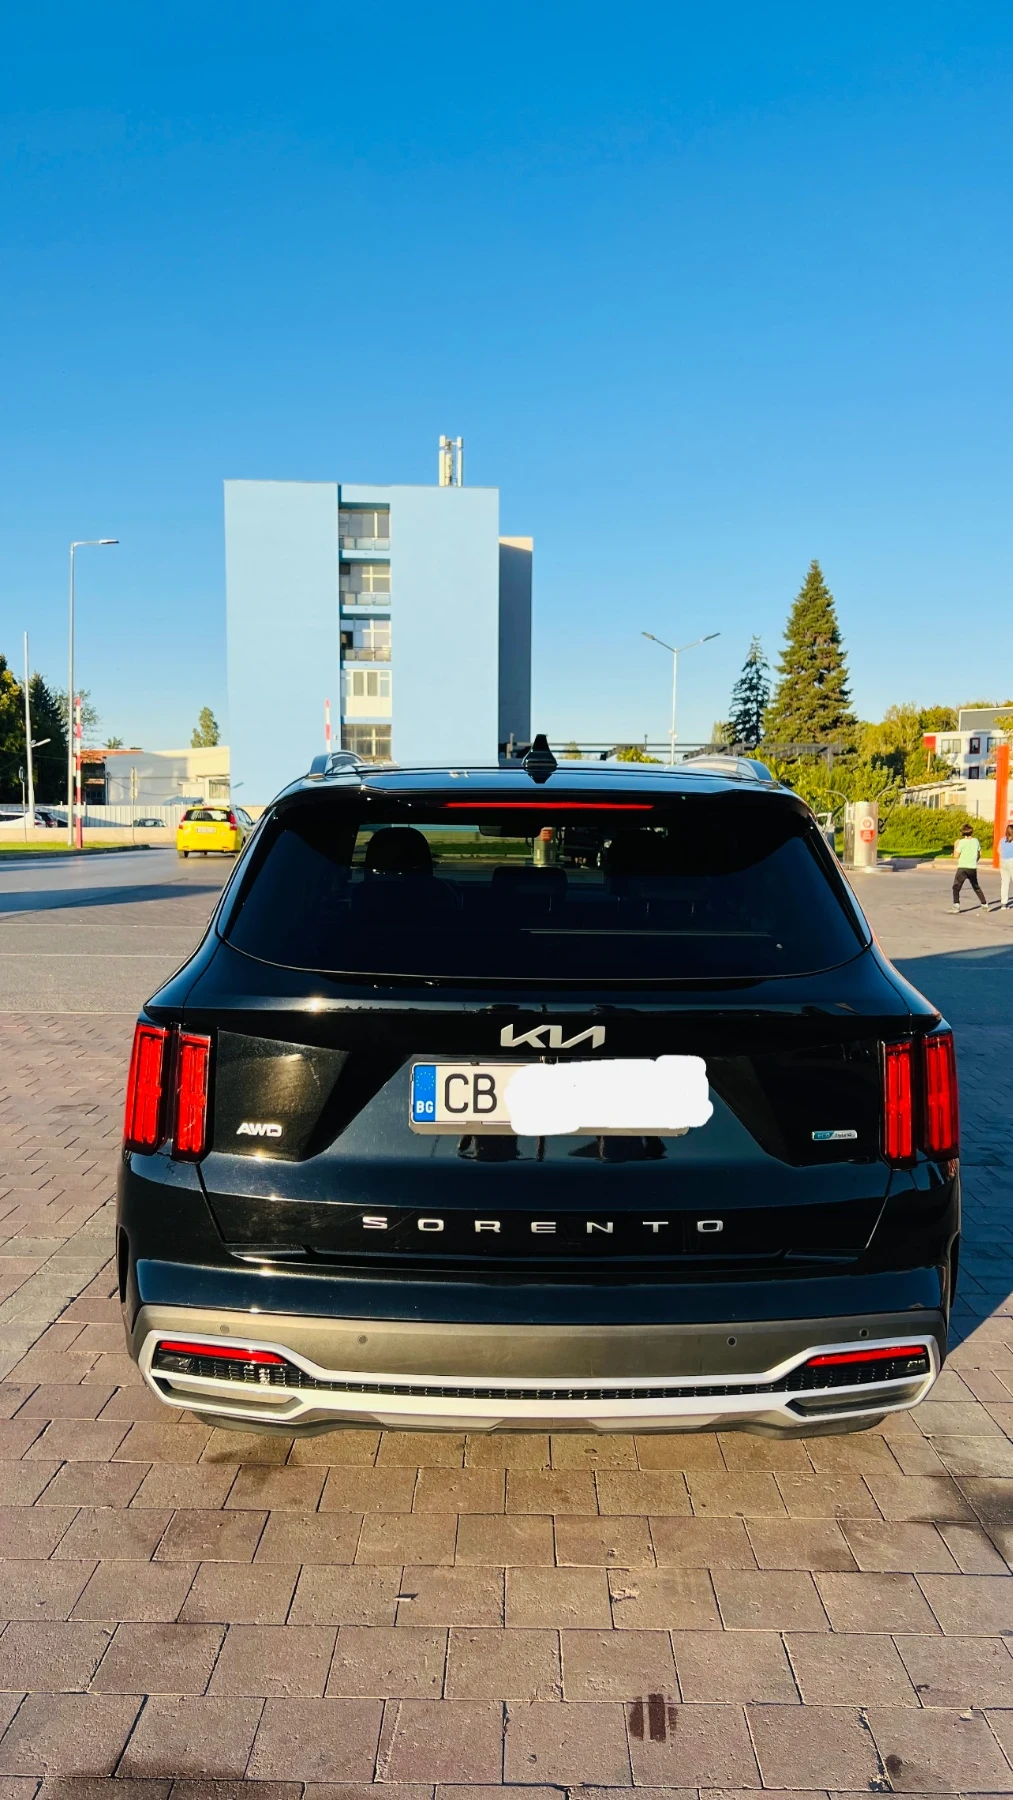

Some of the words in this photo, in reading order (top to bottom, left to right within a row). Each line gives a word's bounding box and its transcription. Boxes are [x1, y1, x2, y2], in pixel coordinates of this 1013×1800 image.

[500, 1024, 606, 1049] KIA
[444, 1073, 498, 1114] CB
[416, 1101, 434, 1114] BG
[236, 1122, 283, 1137] AWD
[362, 1216, 724, 1234] SORENTO
